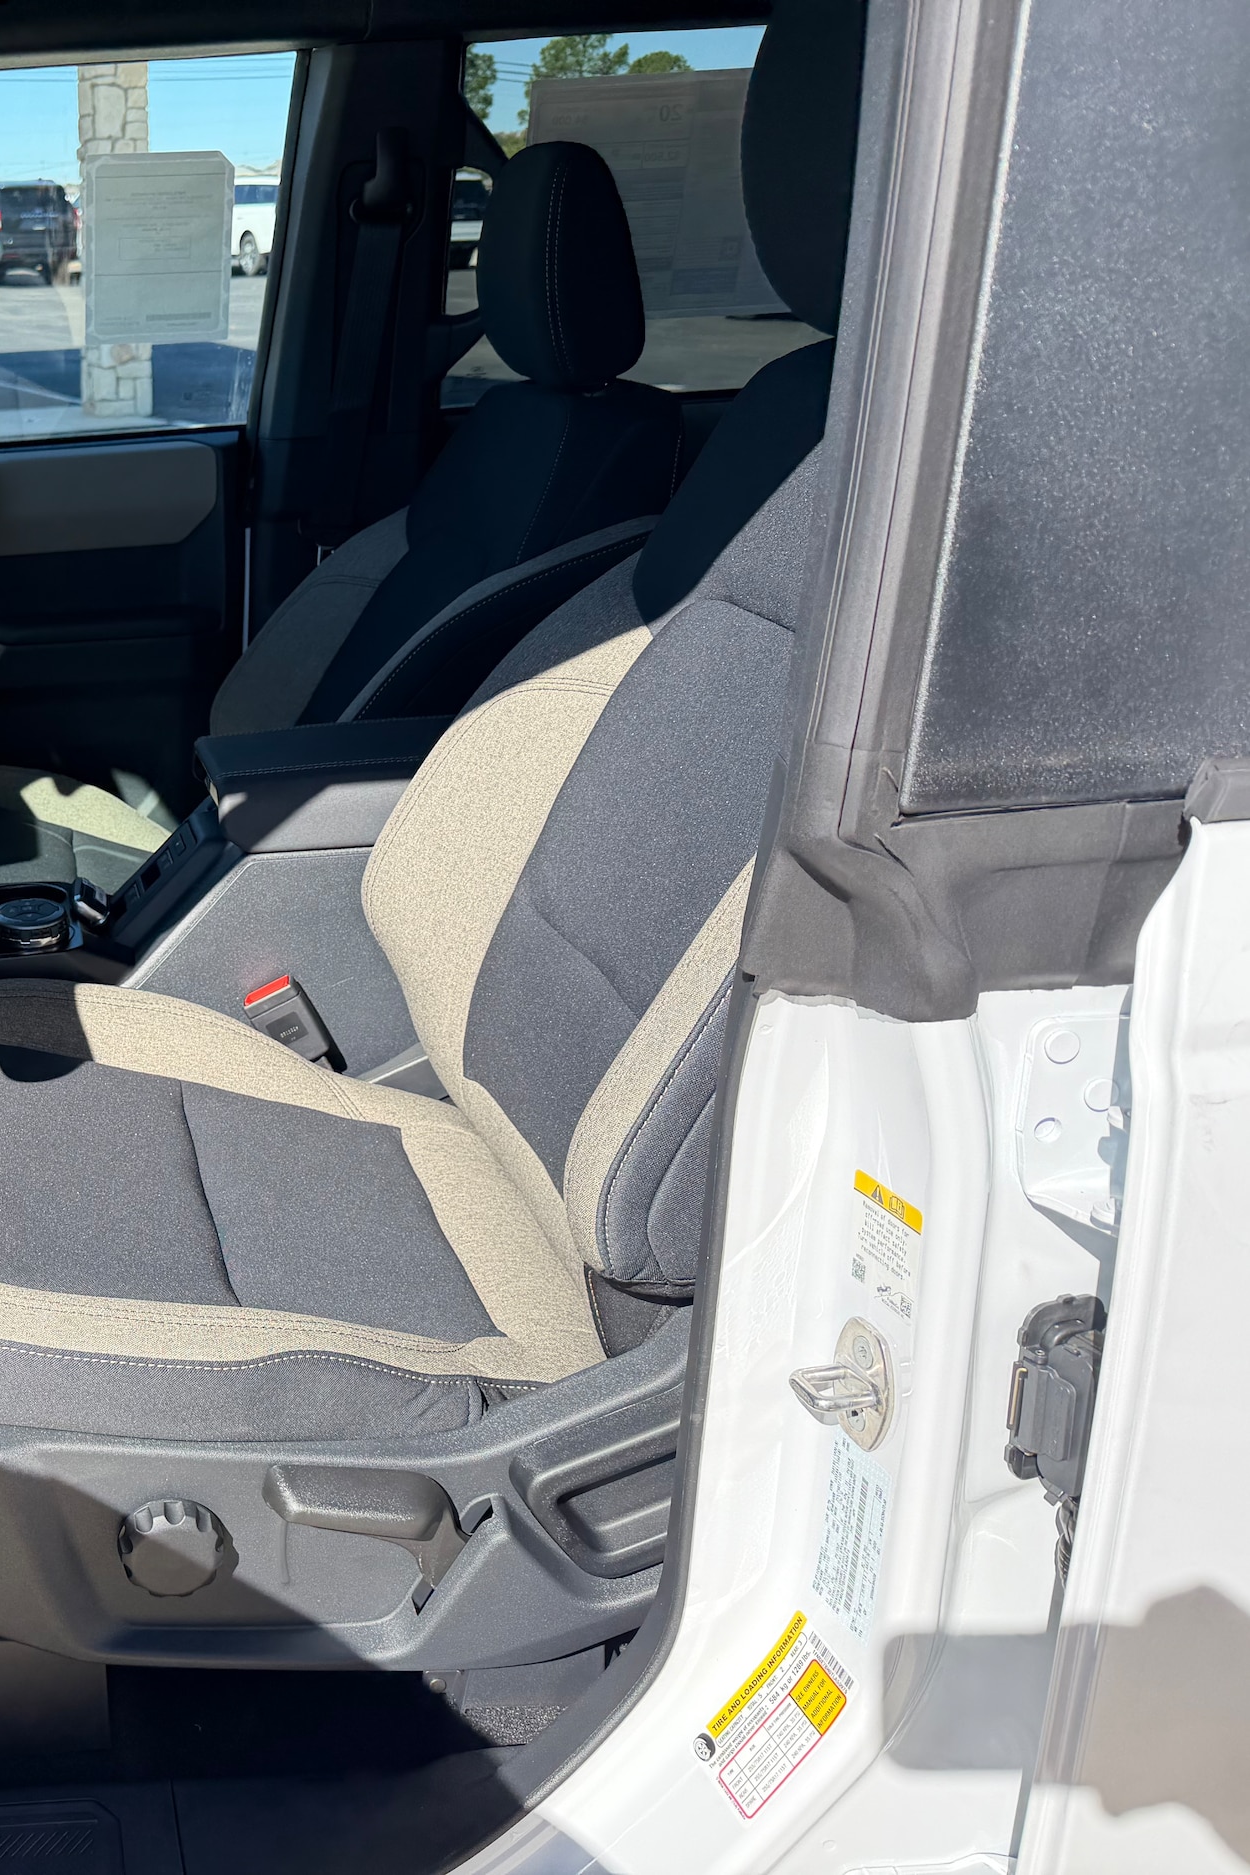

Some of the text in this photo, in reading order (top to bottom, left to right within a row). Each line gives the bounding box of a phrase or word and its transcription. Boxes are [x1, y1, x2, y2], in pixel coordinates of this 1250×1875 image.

[712, 1617, 802, 1731] TIRE AND LOADING INFORMATION
[796, 1670, 819, 1702] SEE OWNERS
[769, 1691, 780, 1704] 584
[780, 1683, 788, 1691] kg
[802, 1679, 826, 1711] MANUAL FOR
[811, 1689, 833, 1718] ADDITIONAL
[817, 1694, 841, 1729] INFORMATION
